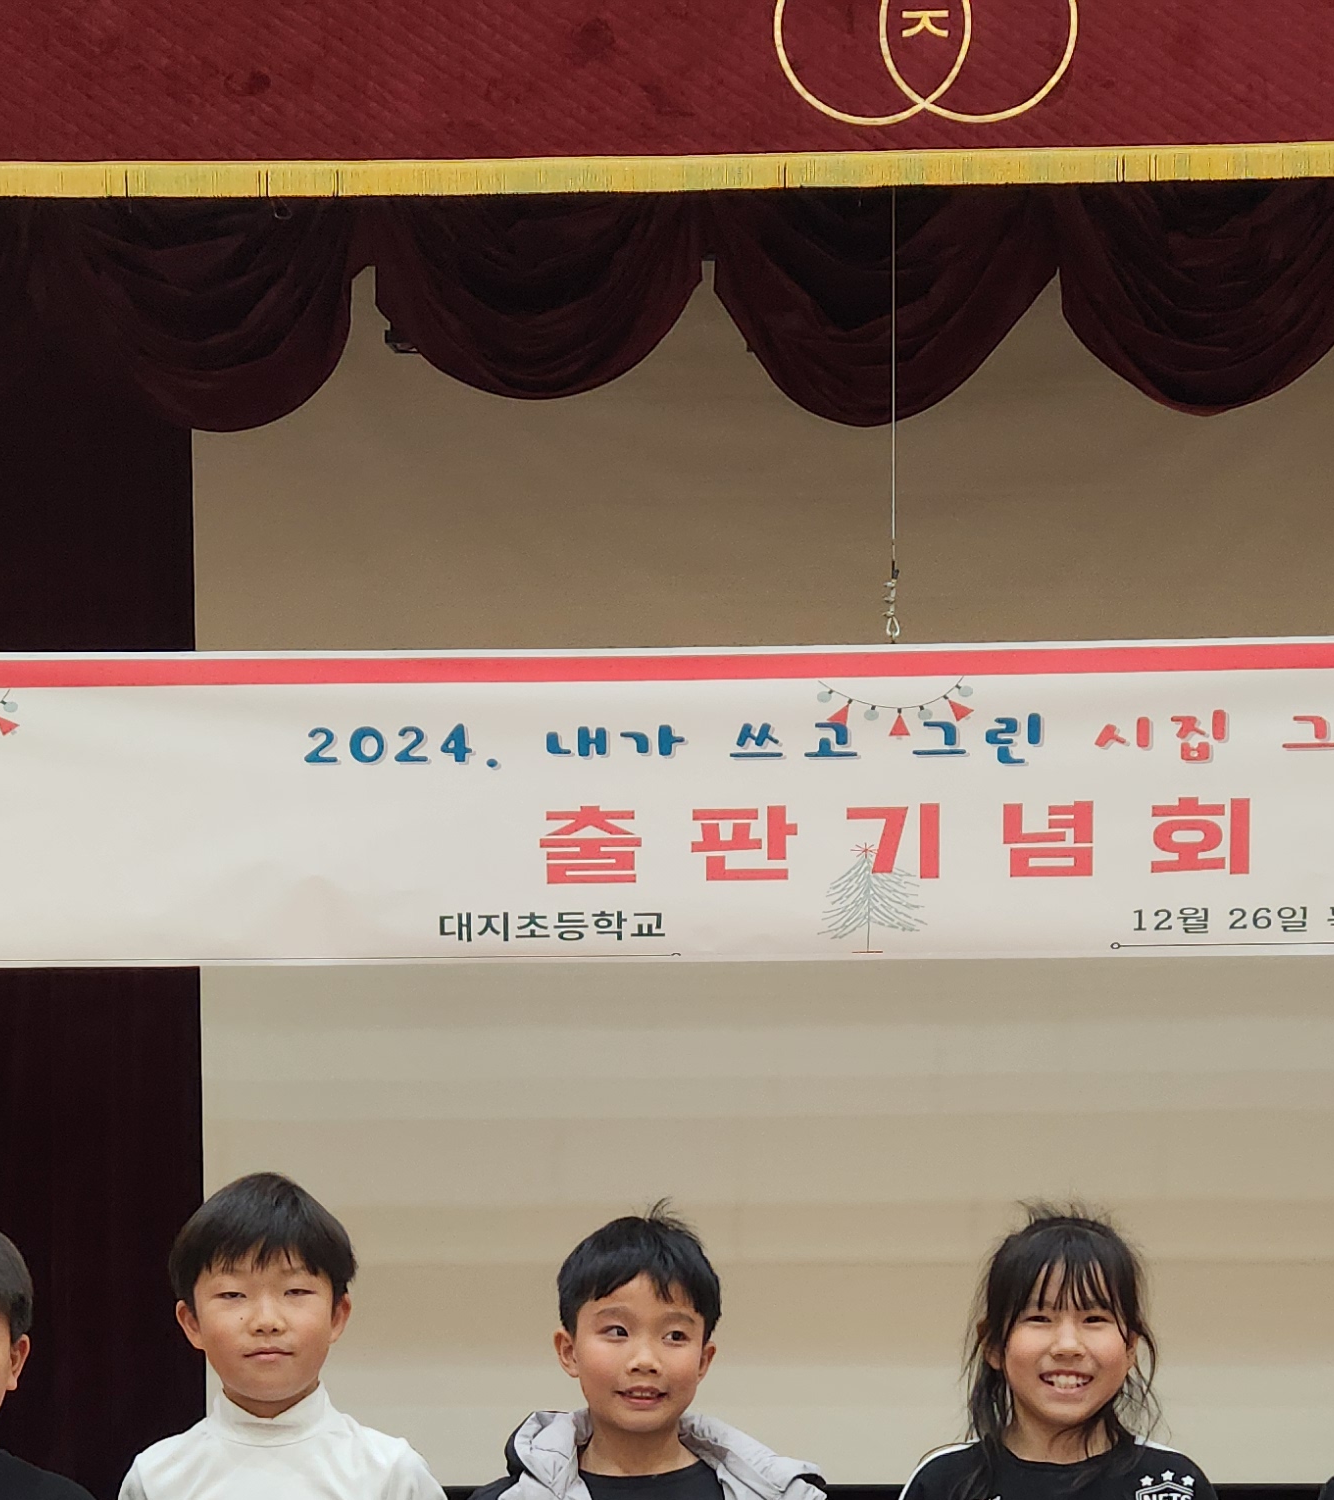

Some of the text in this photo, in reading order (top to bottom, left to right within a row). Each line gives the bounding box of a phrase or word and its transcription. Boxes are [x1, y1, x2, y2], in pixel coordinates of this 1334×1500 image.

[304, 723, 502, 769] 2024.
[546, 724, 685, 757] 내가
[730, 722, 858, 759] 쓰고
[912, 713, 1042, 765] 그린
[1094, 708, 1227, 763] 시집
[438, 911, 665, 942] 대지초등학교
[1132, 907, 1210, 934] 12월
[1228, 906, 1308, 932] 26일
